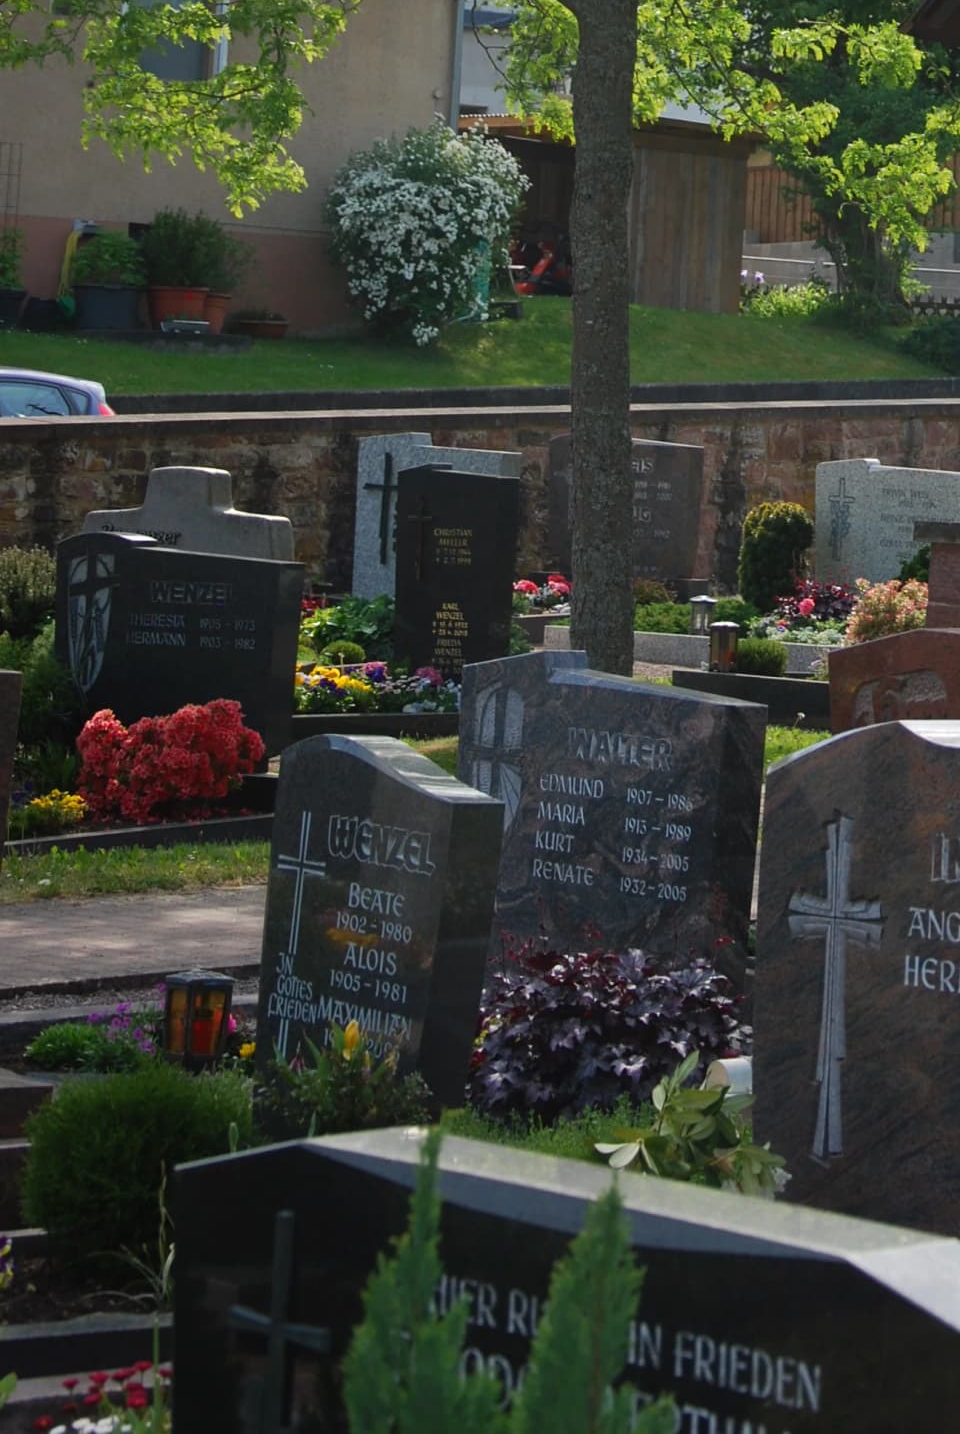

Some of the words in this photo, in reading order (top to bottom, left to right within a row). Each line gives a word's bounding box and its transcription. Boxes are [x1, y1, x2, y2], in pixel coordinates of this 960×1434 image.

[151, 580, 233, 606] WENZEL
[128, 613, 186, 629] THERESIA
[435, 611, 465, 620] WENZEL
[126, 630, 186, 647] HERMANN
[433, 648, 463, 657] WENZEL
[568, 726, 673, 771] WALTER
[540, 773, 604, 799] EDMUND
[626, 787, 652, 807] 1907
[667, 792, 694, 813] 1986
[537, 800, 586, 826] MARIA
[665, 823, 692, 842] 1989
[327, 814, 437, 877] WENZEL
[535, 829, 575, 854] KURT
[622, 847, 648, 865] 1934
[660, 853, 690, 872] 2005
[532, 858, 594, 887] RENATE
[619, 876, 646, 896] 1932
[657, 882, 688, 902] 2005
[348, 882, 406, 917] BEATE
[336, 911, 367, 935] 1902
[380, 919, 413, 944] 1980
[343, 941, 398, 977] ALOIS
[276, 973, 313, 1001] GOTTES
[329, 969, 361, 992] 1905
[374, 978, 408, 1004] 1981
[267, 992, 318, 1025] FRIEDEN
[316, 994, 413, 1041] MAXIMILIAN
[628, 1320, 662, 1367] IN
[673, 1330, 822, 1413] FRIEDEN
